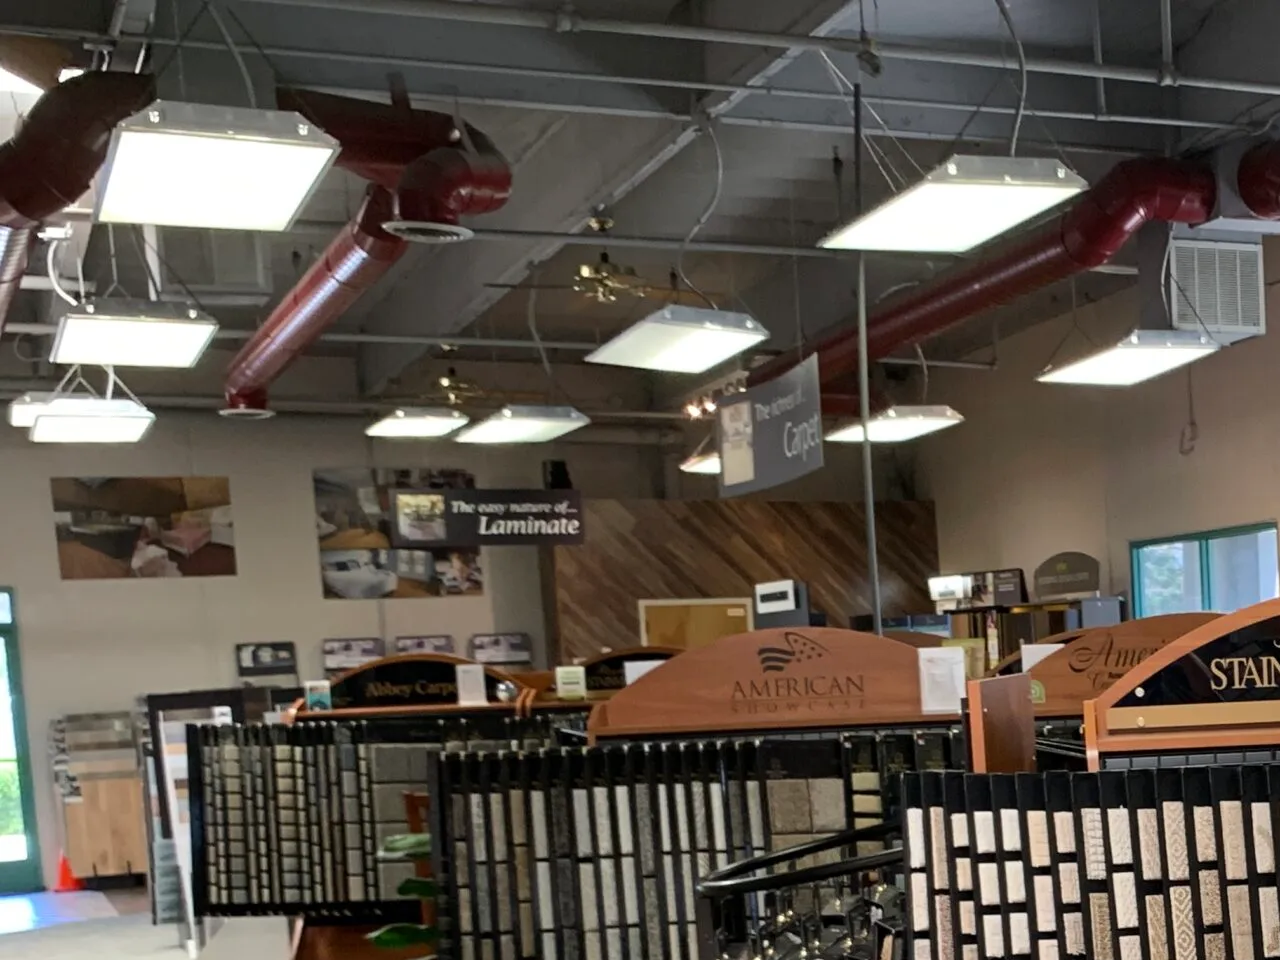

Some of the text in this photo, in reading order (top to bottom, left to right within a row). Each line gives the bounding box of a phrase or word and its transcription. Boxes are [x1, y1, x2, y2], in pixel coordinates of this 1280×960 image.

[451, 500, 475, 514] The
[479, 515, 580, 535] Laminate
[365, 679, 457, 699] Abbey Carpe
[731, 675, 864, 699] AMERICAN
